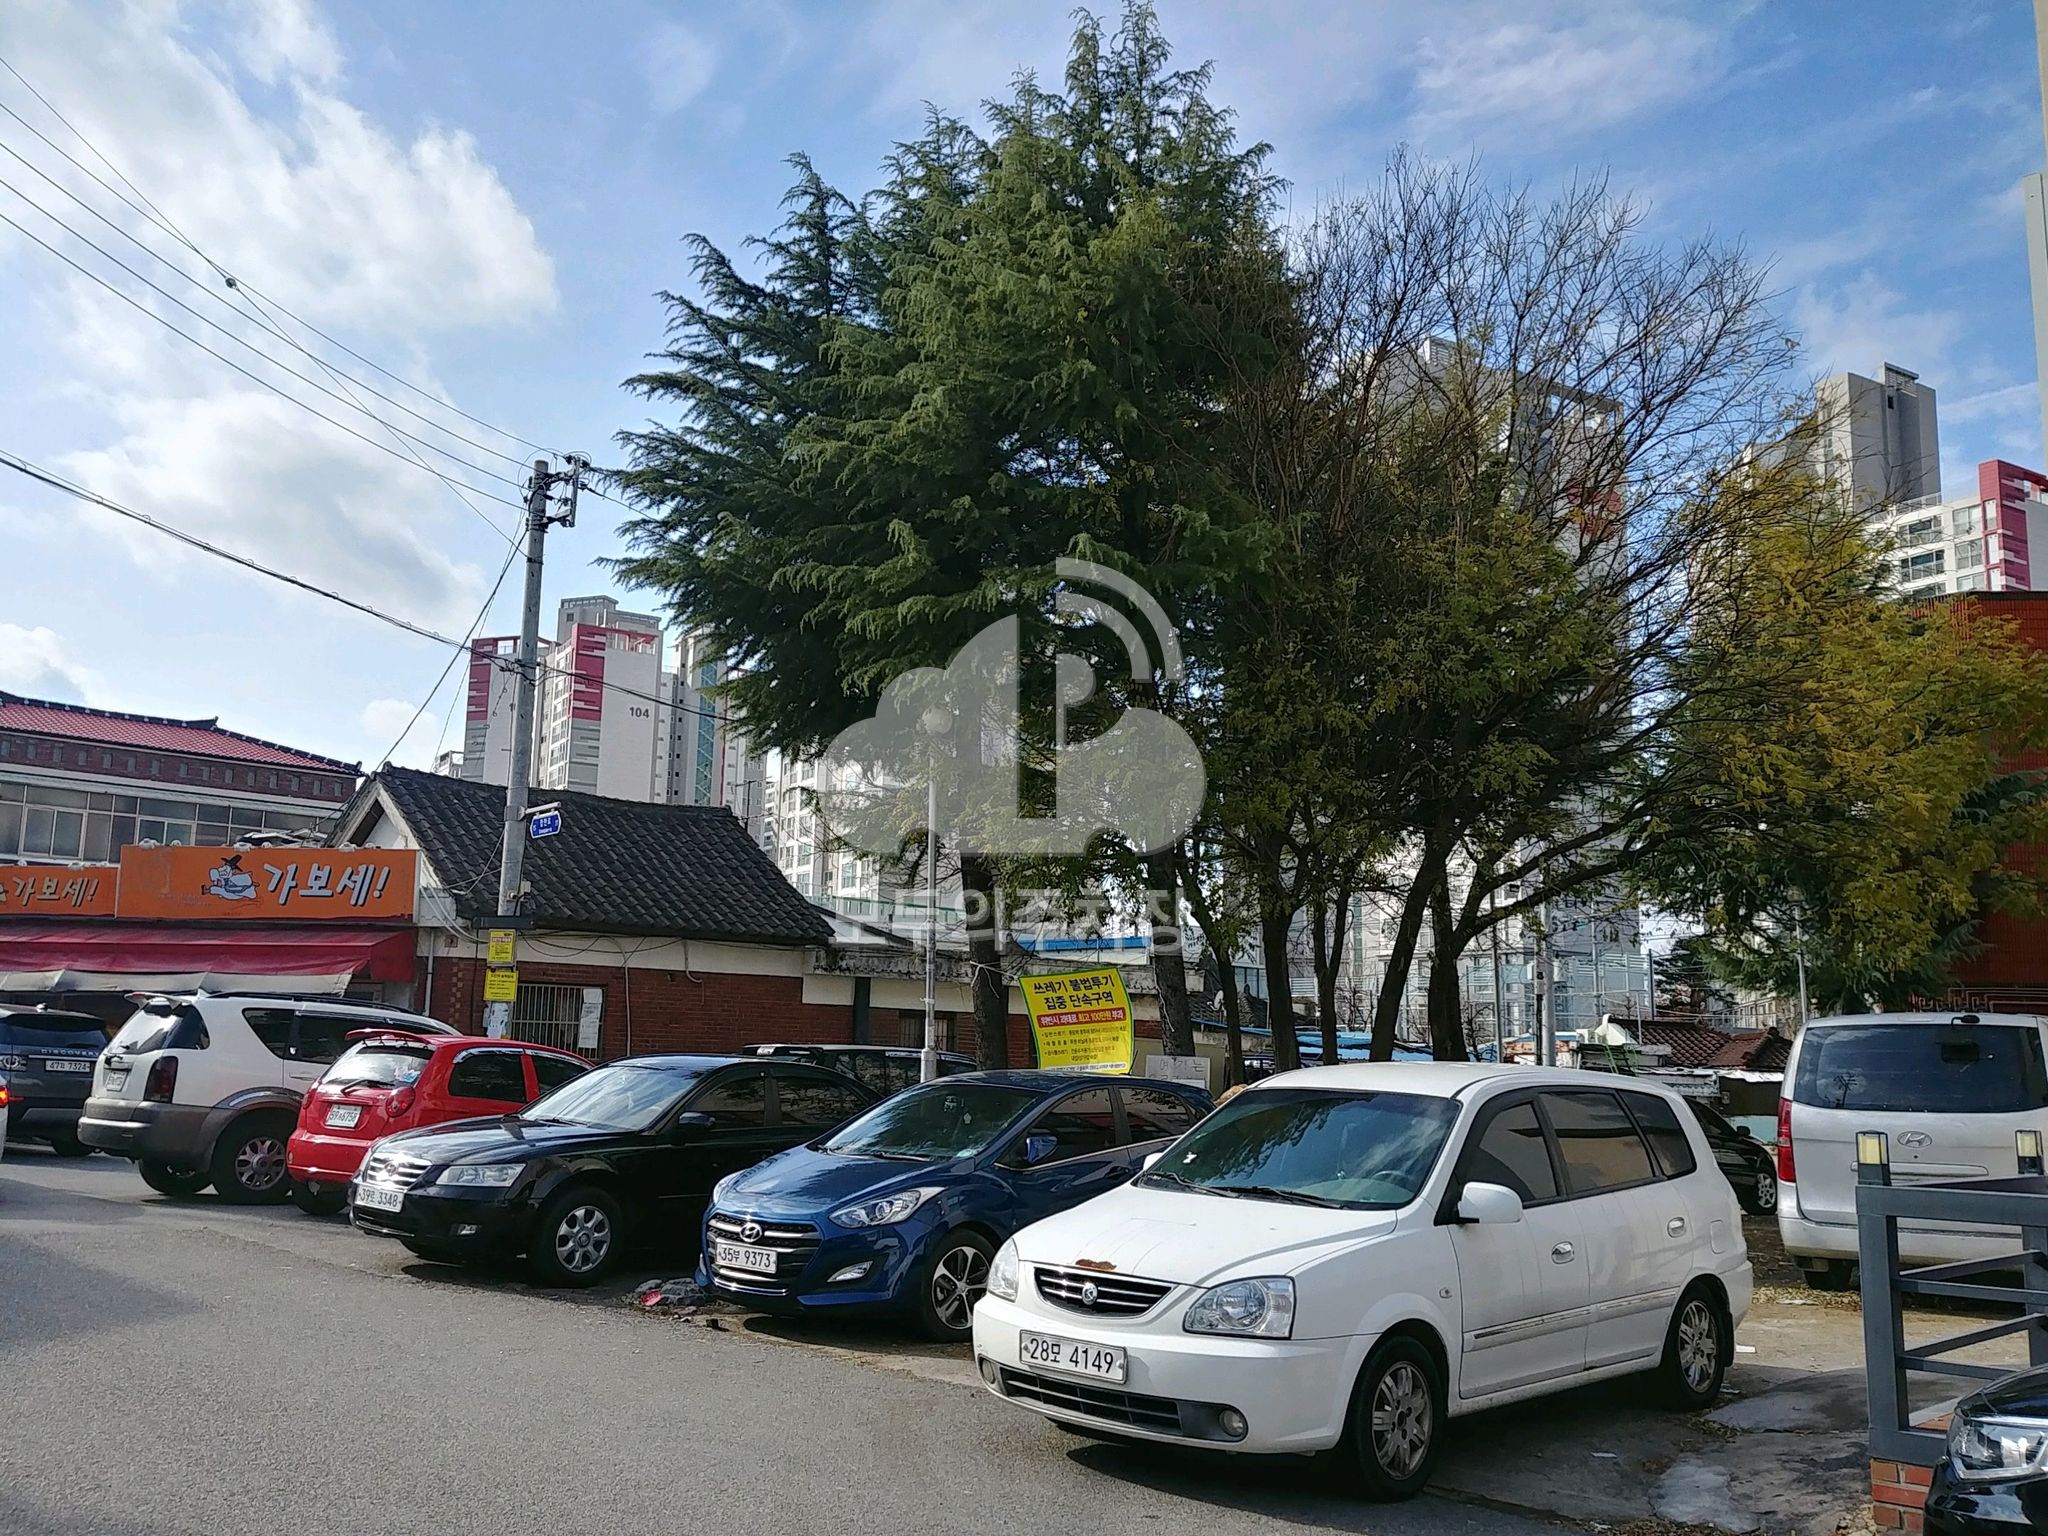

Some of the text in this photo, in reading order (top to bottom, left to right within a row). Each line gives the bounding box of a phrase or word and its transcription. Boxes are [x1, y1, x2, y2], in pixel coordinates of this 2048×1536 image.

[629, 707, 650, 718] 104
[12, 876, 99, 907] 가보세!
[263, 864, 390, 905] 가보세!
[1034, 975, 1115, 994] 쓰레기 불법투기
[1044, 991, 1115, 1010] 집중 단속구역
[41, 1049, 99, 1057] DISCOVERY
[377, 1191, 399, 1207] 3348
[721, 1247, 771, 1268] 35부 9373
[1030, 1338, 1114, 1374] 28모 4149
